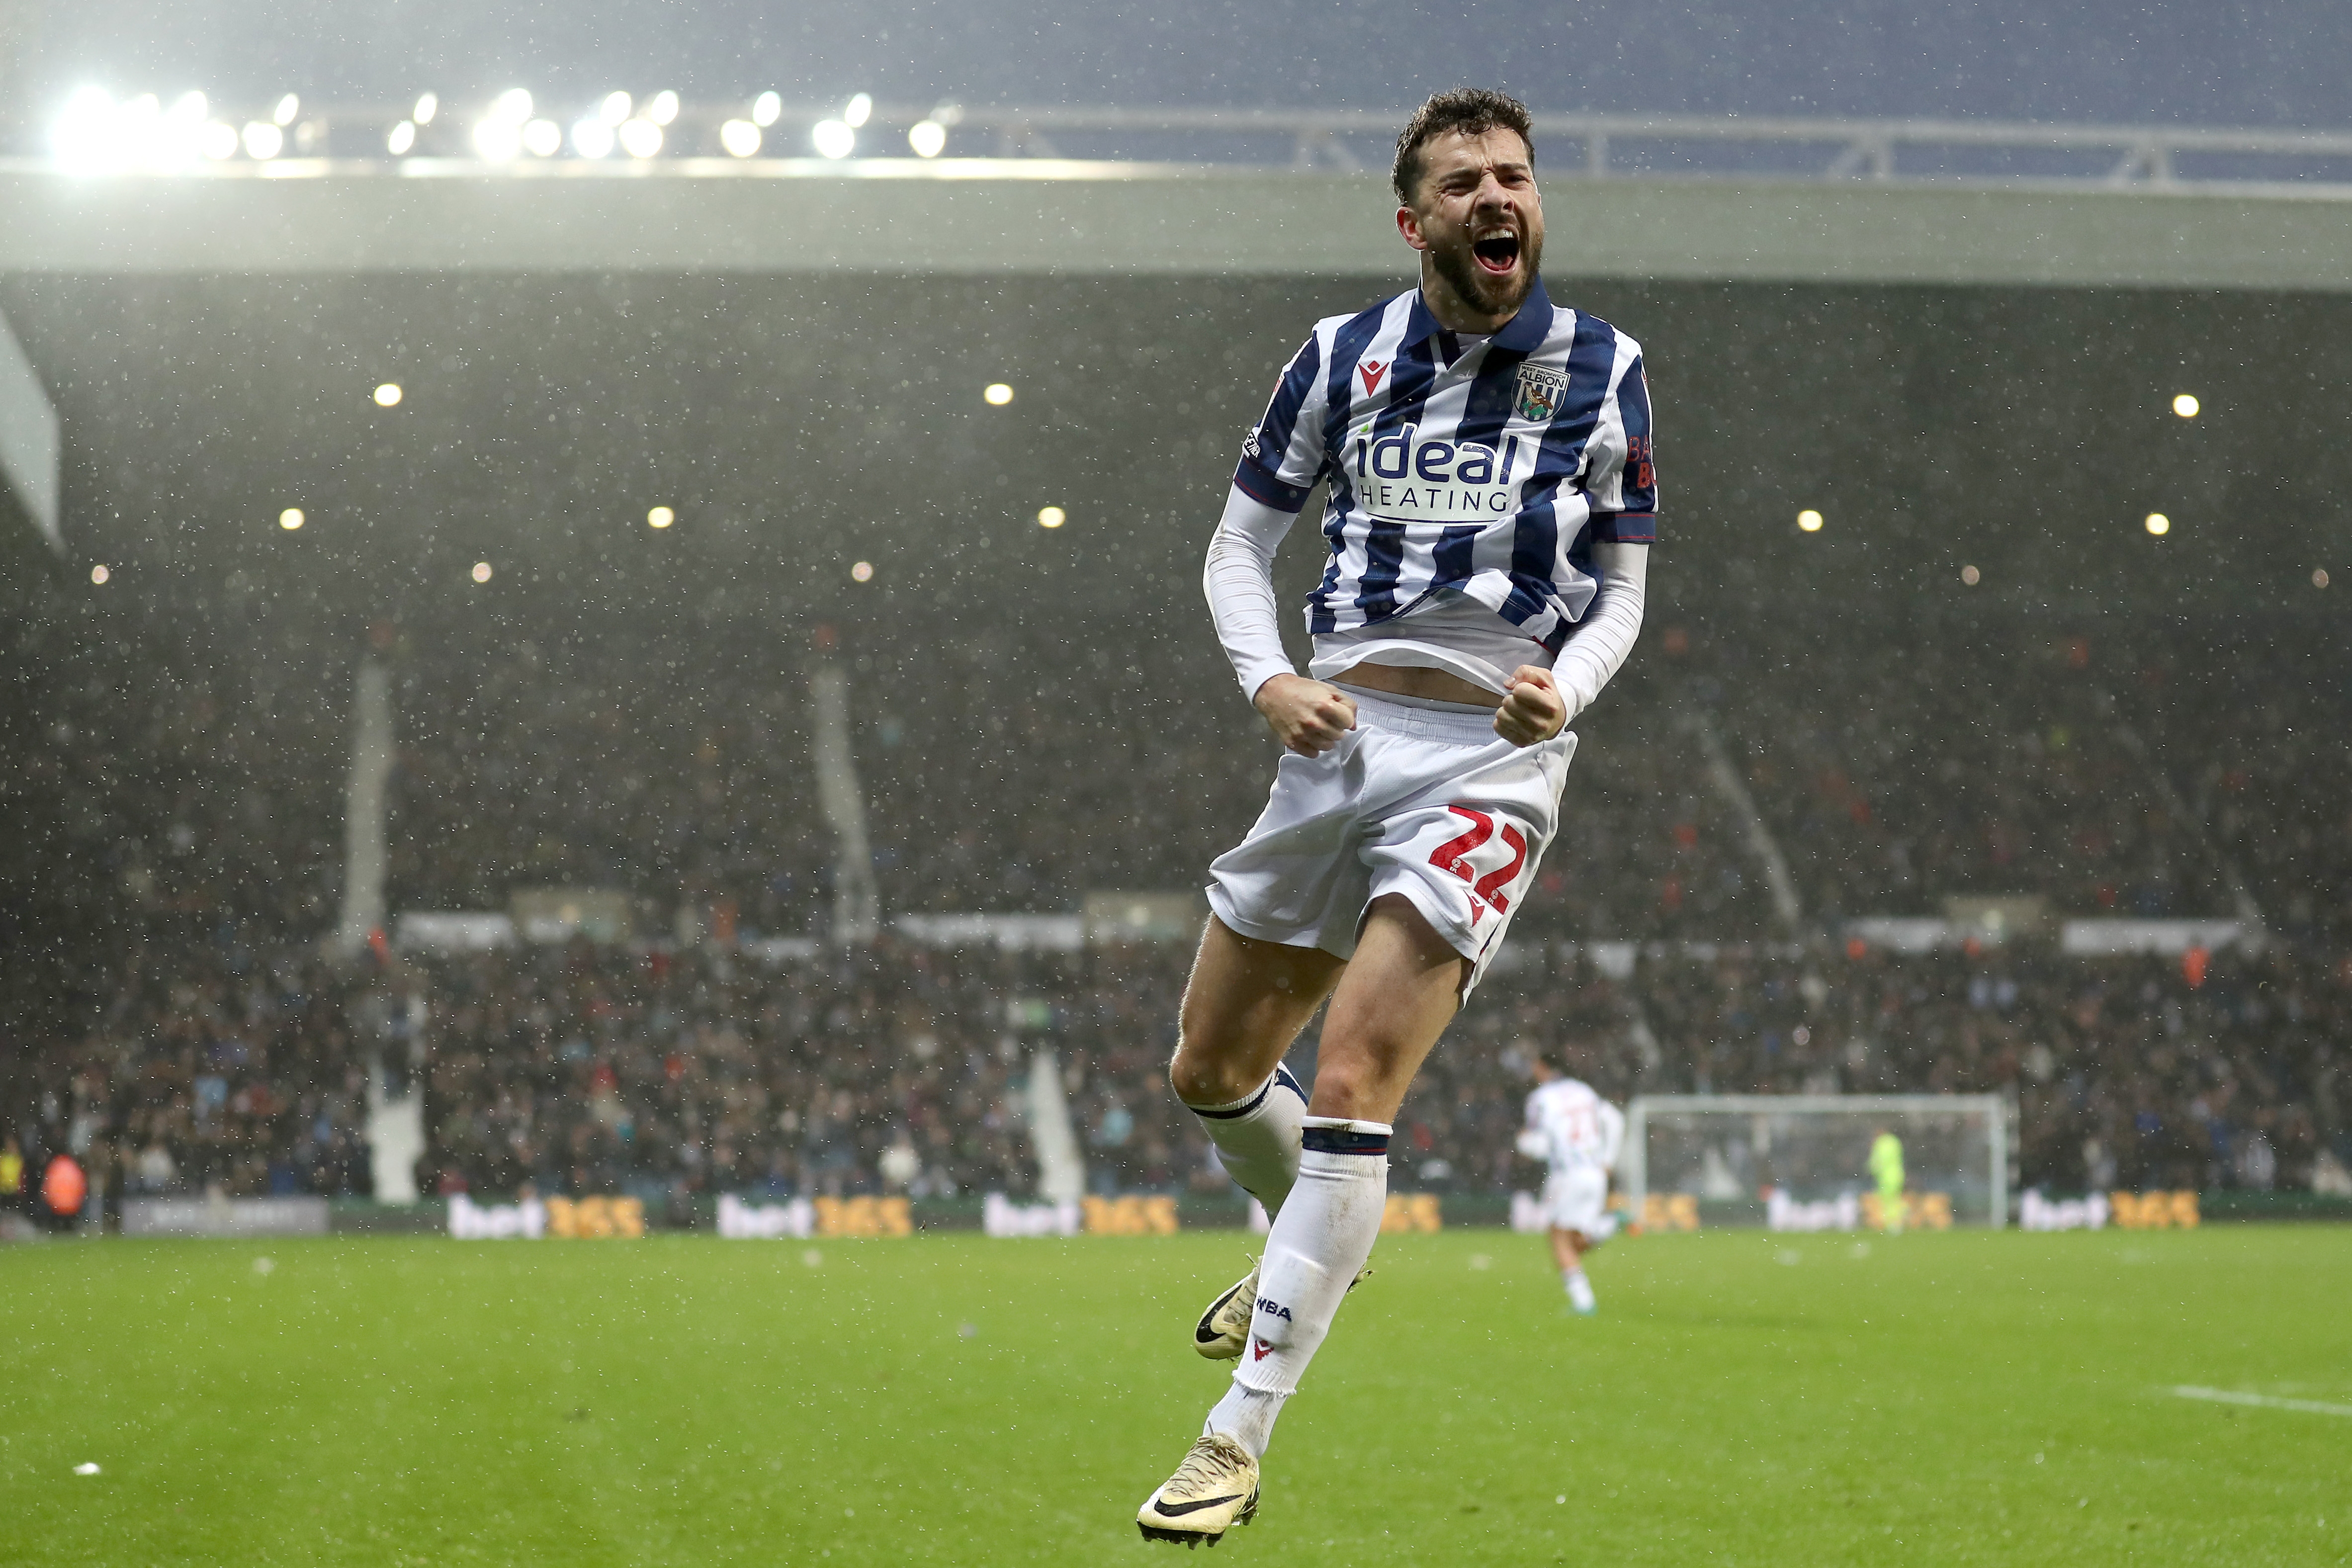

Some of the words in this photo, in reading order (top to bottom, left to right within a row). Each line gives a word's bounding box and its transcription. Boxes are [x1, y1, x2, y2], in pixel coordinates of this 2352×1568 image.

[1519, 370, 1565, 388] ALBION
[1537, 369, 1566, 379] BROMWICH
[1357, 423, 1518, 485] ideal
[1360, 484, 1507, 512] HEATING
[1428, 804, 1526, 915] 22
[1257, 1295, 1292, 1322] WBA
